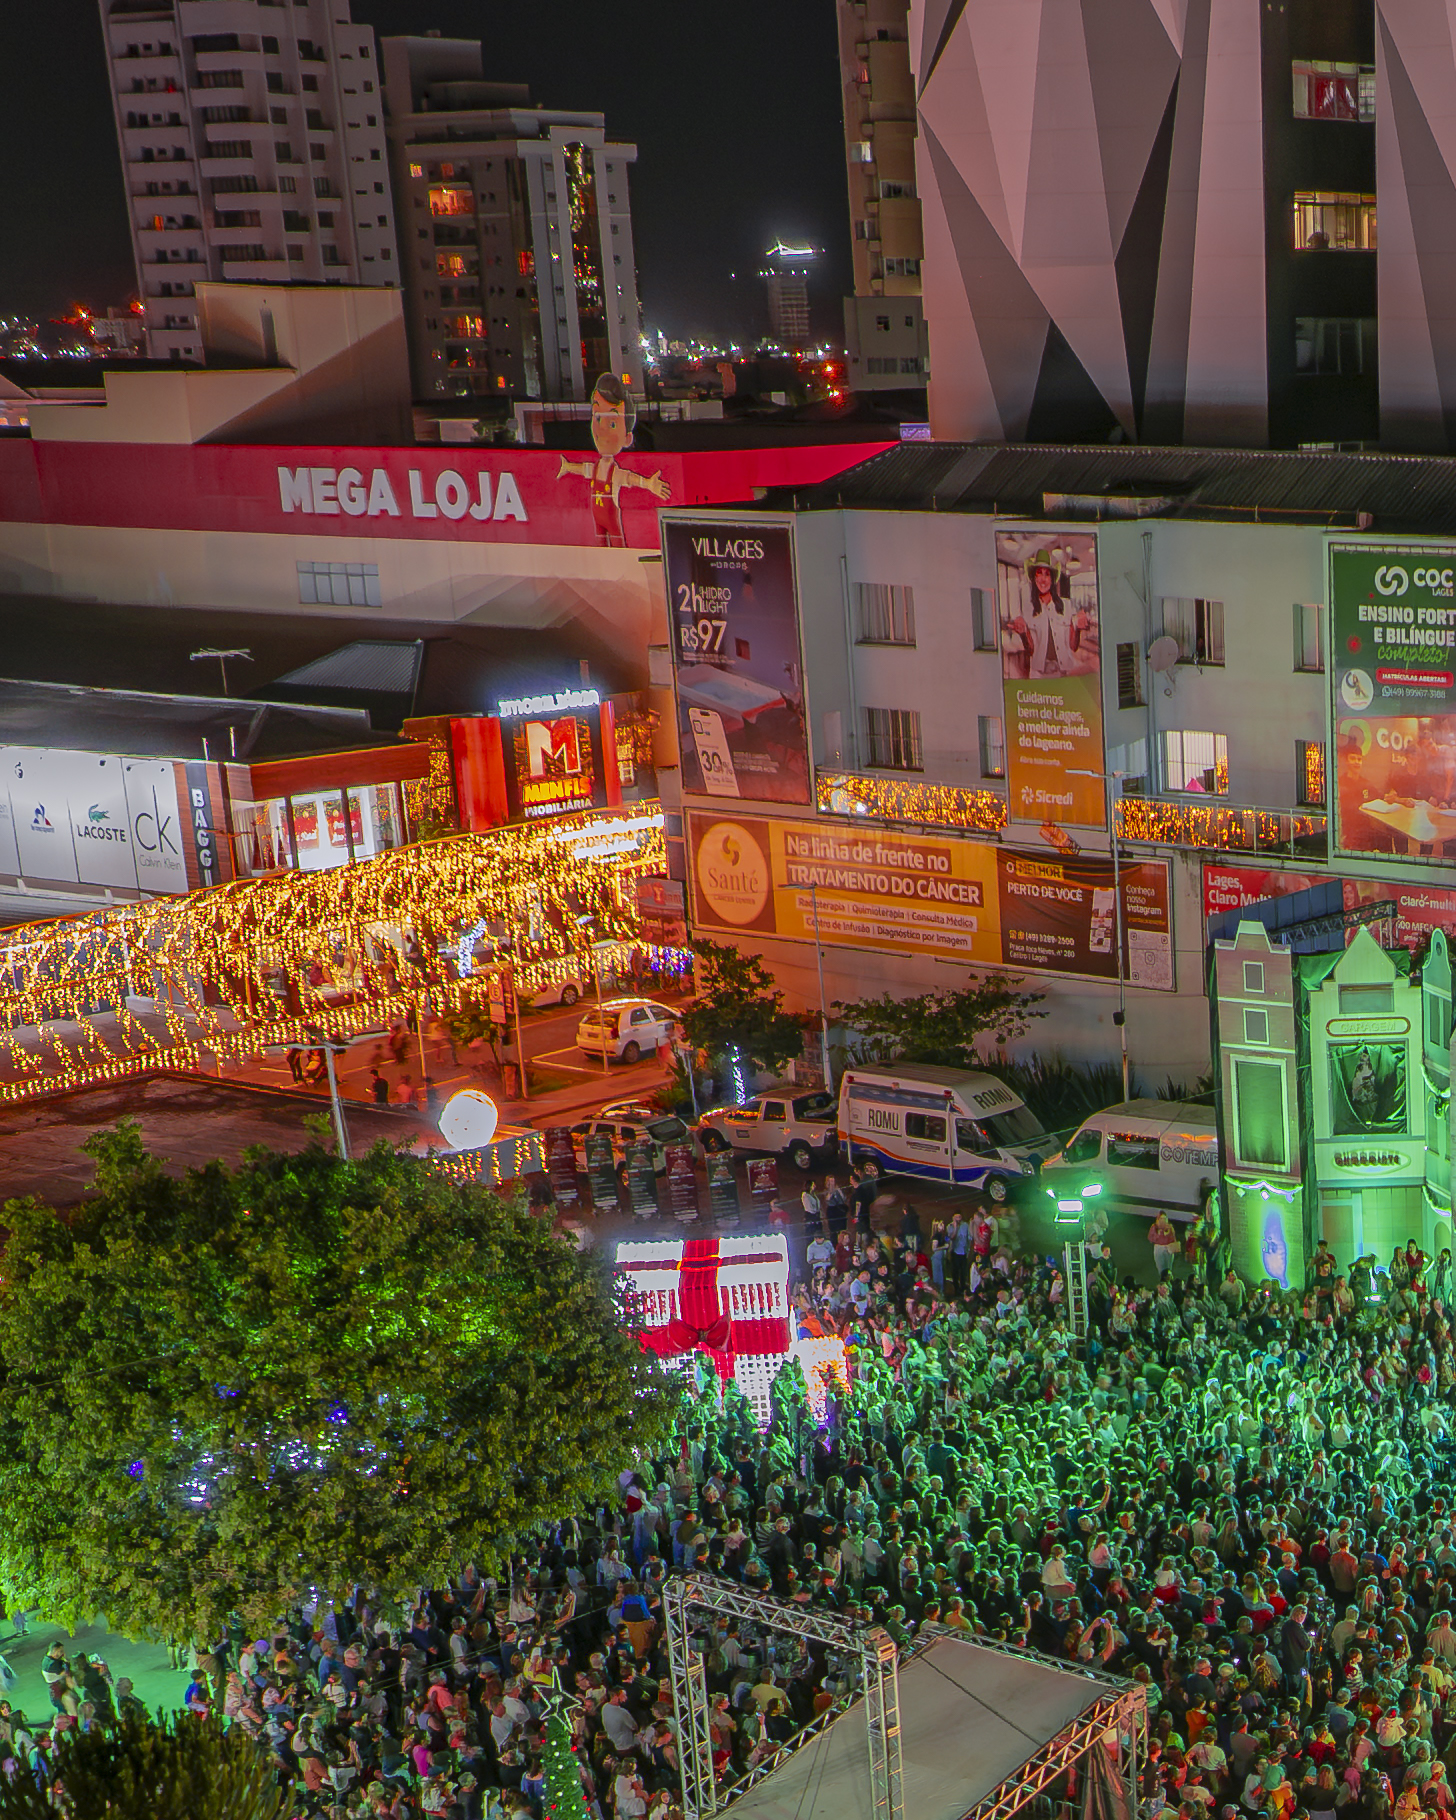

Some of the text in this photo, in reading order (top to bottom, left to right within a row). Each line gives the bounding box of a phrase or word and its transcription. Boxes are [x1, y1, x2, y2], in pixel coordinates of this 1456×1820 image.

[278, 466, 529, 522] MEGA LOJA
[691, 537, 765, 560] VILLAGES
[1413, 568, 1454, 588] COC
[1358, 604, 1414, 624] ENSINO
[1373, 624, 1456, 647] E BILÍNGUE
[1016, 689, 1064, 706] Cuidamos
[1017, 704, 1039, 718] bem
[1040, 707, 1053, 720] de
[1018, 721, 1091, 737] e melhor ainda
[525, 716, 582, 779] M
[1018, 734, 1032, 747] do
[523, 777, 592, 805] MENFIS
[1035, 789, 1073, 806] Sicredi
[76, 824, 127, 843] LACOSTE
[191, 788, 213, 887] BAGGI
[787, 834, 949, 872] Na linha de frente no
[164, 857, 182, 871] Klein
[708, 867, 759, 894] Santé
[787, 863, 981, 905] TRATAMENTO DO CÂNCER
[1125, 884, 1156, 897] Conheça
[1207, 871, 1244, 891] Lages,
[1007, 881, 1083, 902] PERTO DE VOCÊ
[1208, 889, 1272, 907] Claro Mult
[798, 896, 845, 912] Radoterapia
[852, 904, 905, 920] Quimioterapia
[911, 908, 945, 925] Consulta
[1126, 905, 1162, 917] Instagram
[1340, 1021, 1396, 1033] GARAGEM
[972, 1086, 1013, 1110] ROMU
[867, 1107, 900, 1131] ROMU
